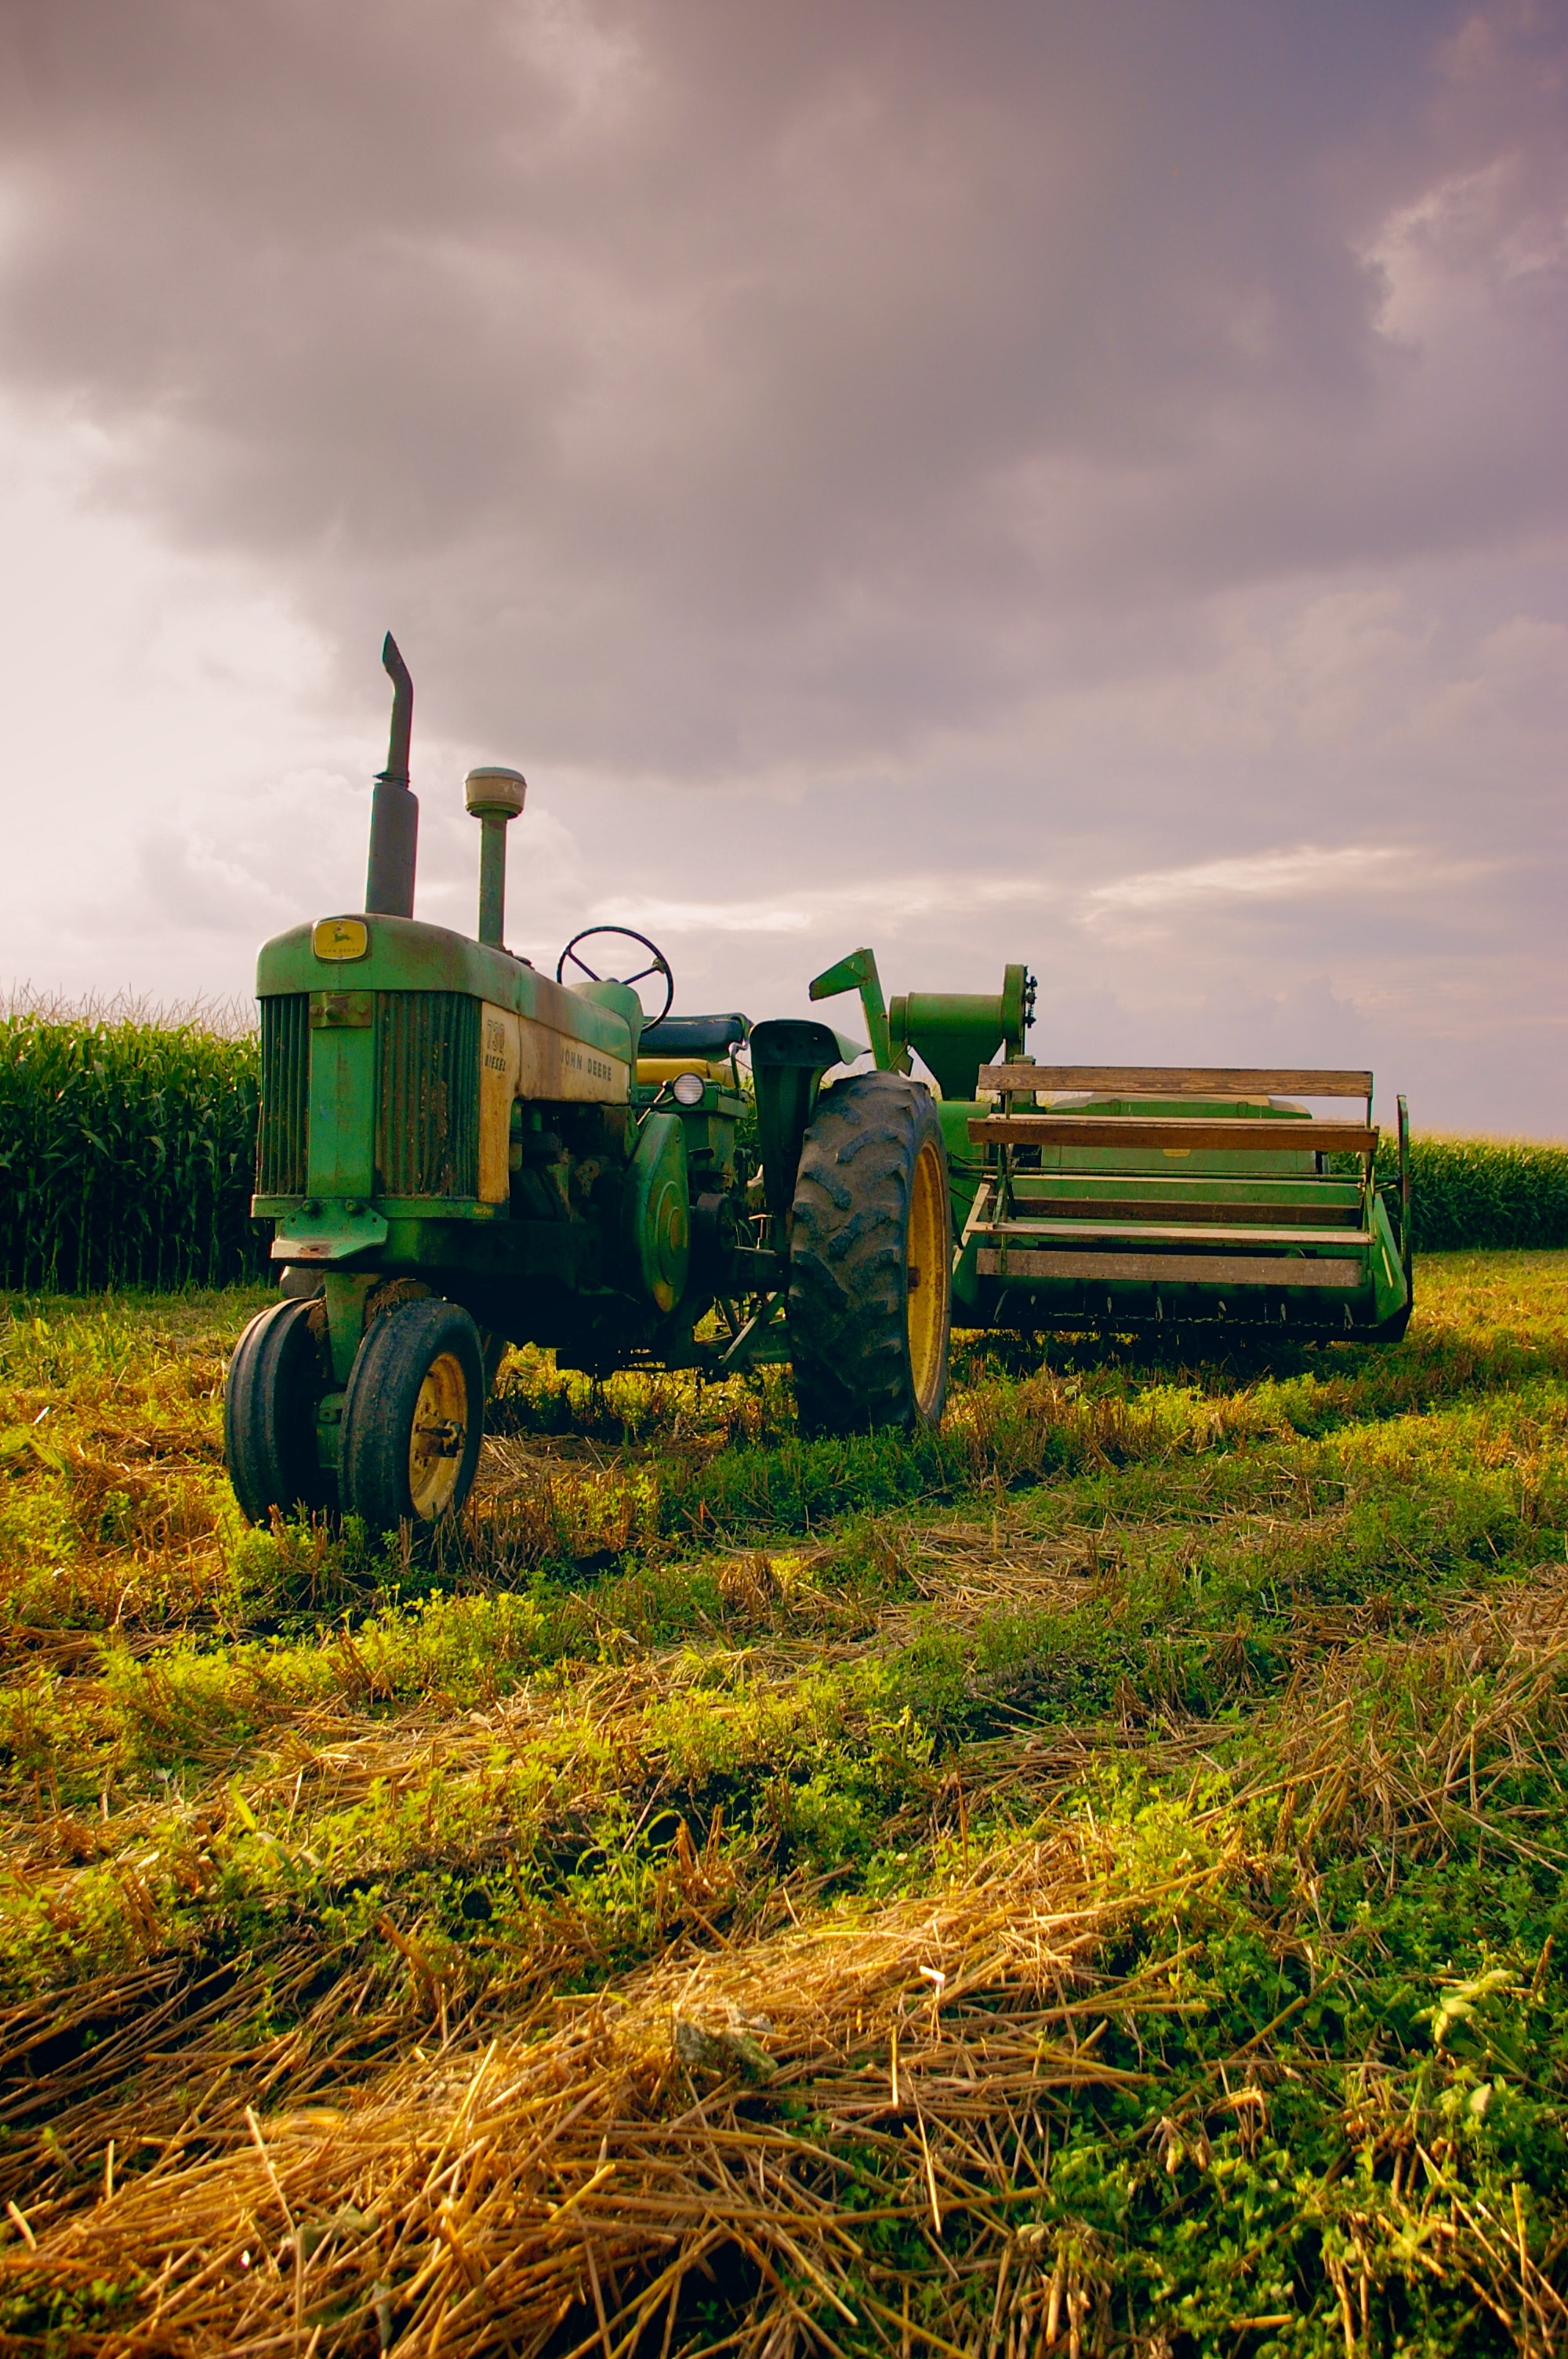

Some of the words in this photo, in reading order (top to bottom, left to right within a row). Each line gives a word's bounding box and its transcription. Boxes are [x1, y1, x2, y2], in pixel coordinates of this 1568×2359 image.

[485, 1054, 506, 1071] DIESEL
[561, 1048, 583, 1071] JOHN
[587, 1058, 612, 1081] DEERE
